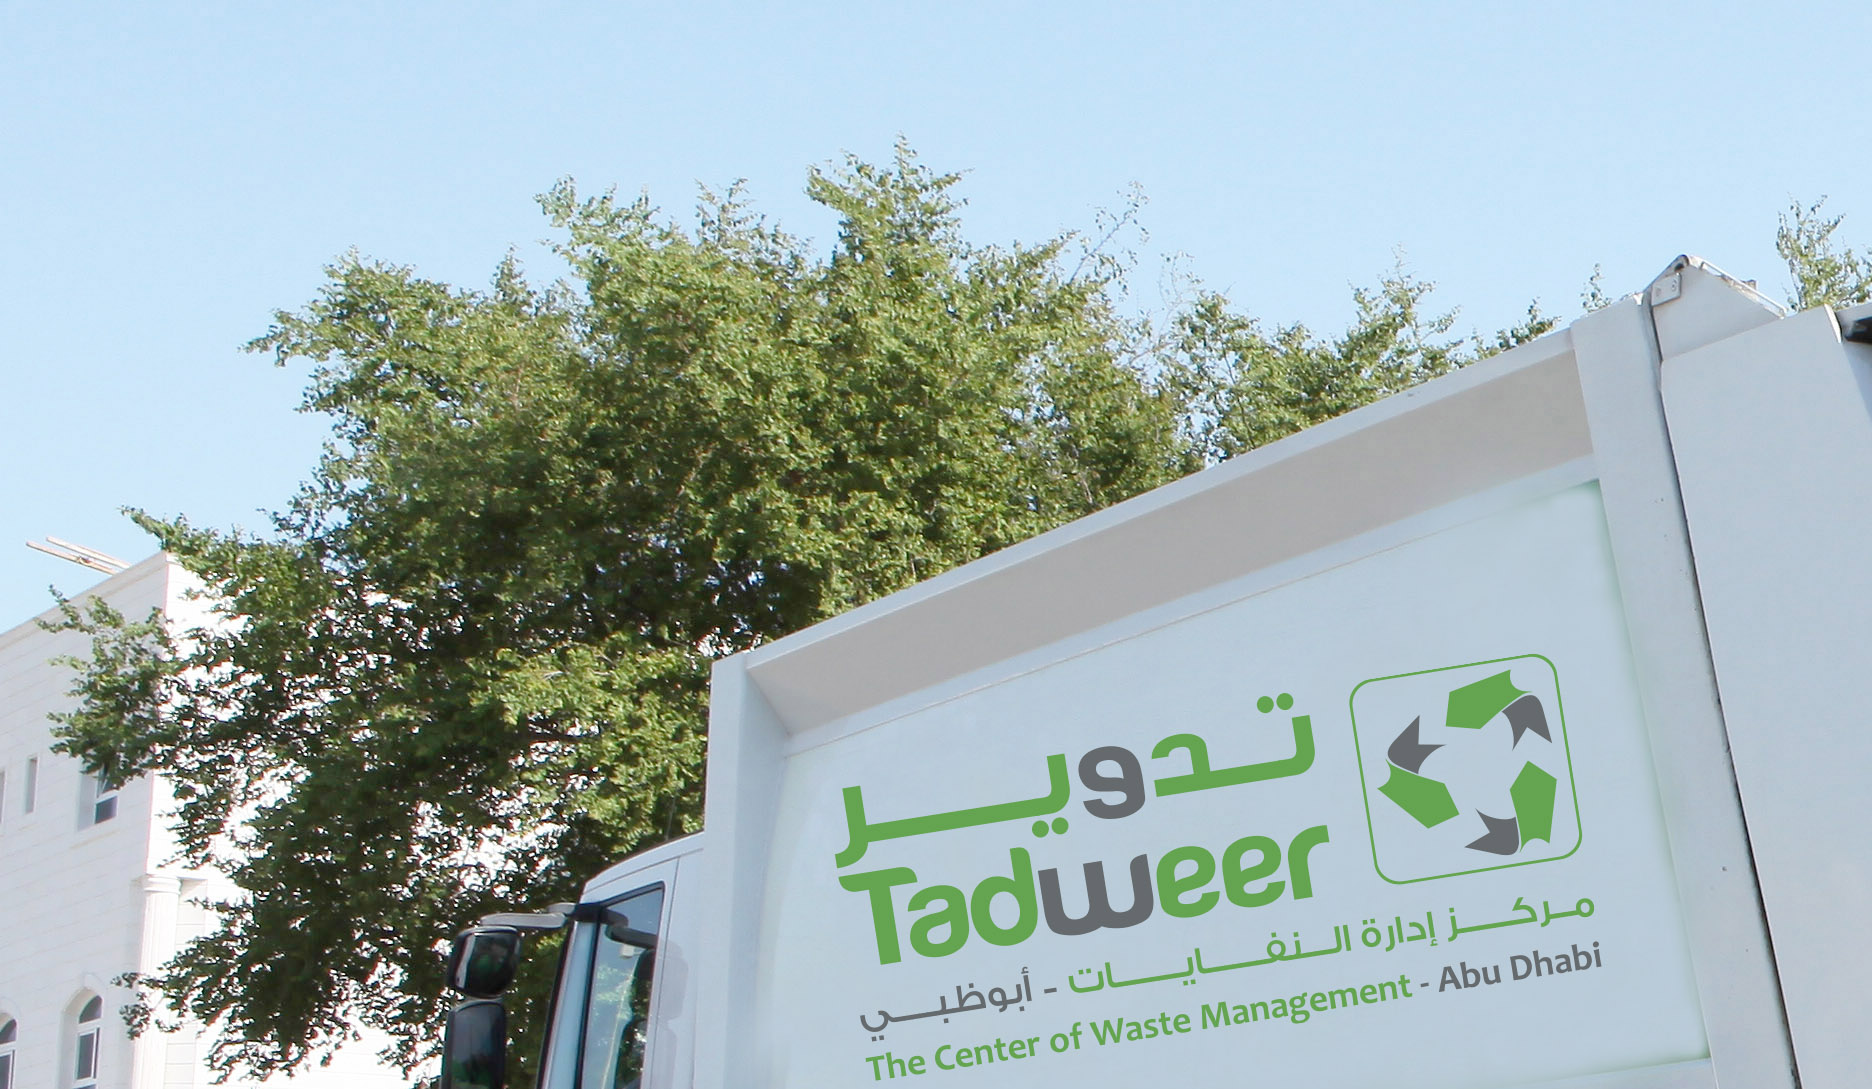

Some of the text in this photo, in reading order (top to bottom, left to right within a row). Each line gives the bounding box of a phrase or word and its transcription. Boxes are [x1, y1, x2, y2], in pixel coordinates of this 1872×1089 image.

[834, 692, 1316, 869] تدوير
[838, 824, 1330, 966] Tadweer
[1361, 911, 1439, 953] إدارة
[1447, 896, 1595, 942] مركز
[1068, 924, 1352, 995] النفايات
[859, 966, 1033, 1042] أبوظبي
[865, 1050, 927, 1082] The
[934, 1034, 1041, 1072] Center
[1049, 1021, 1083, 1054] of
[1088, 1011, 1193, 1047] Waste
[1200, 973, 1414, 1031] Management
[1438, 960, 1503, 995] Abu
[1509, 940, 1603, 982] Dhabi
